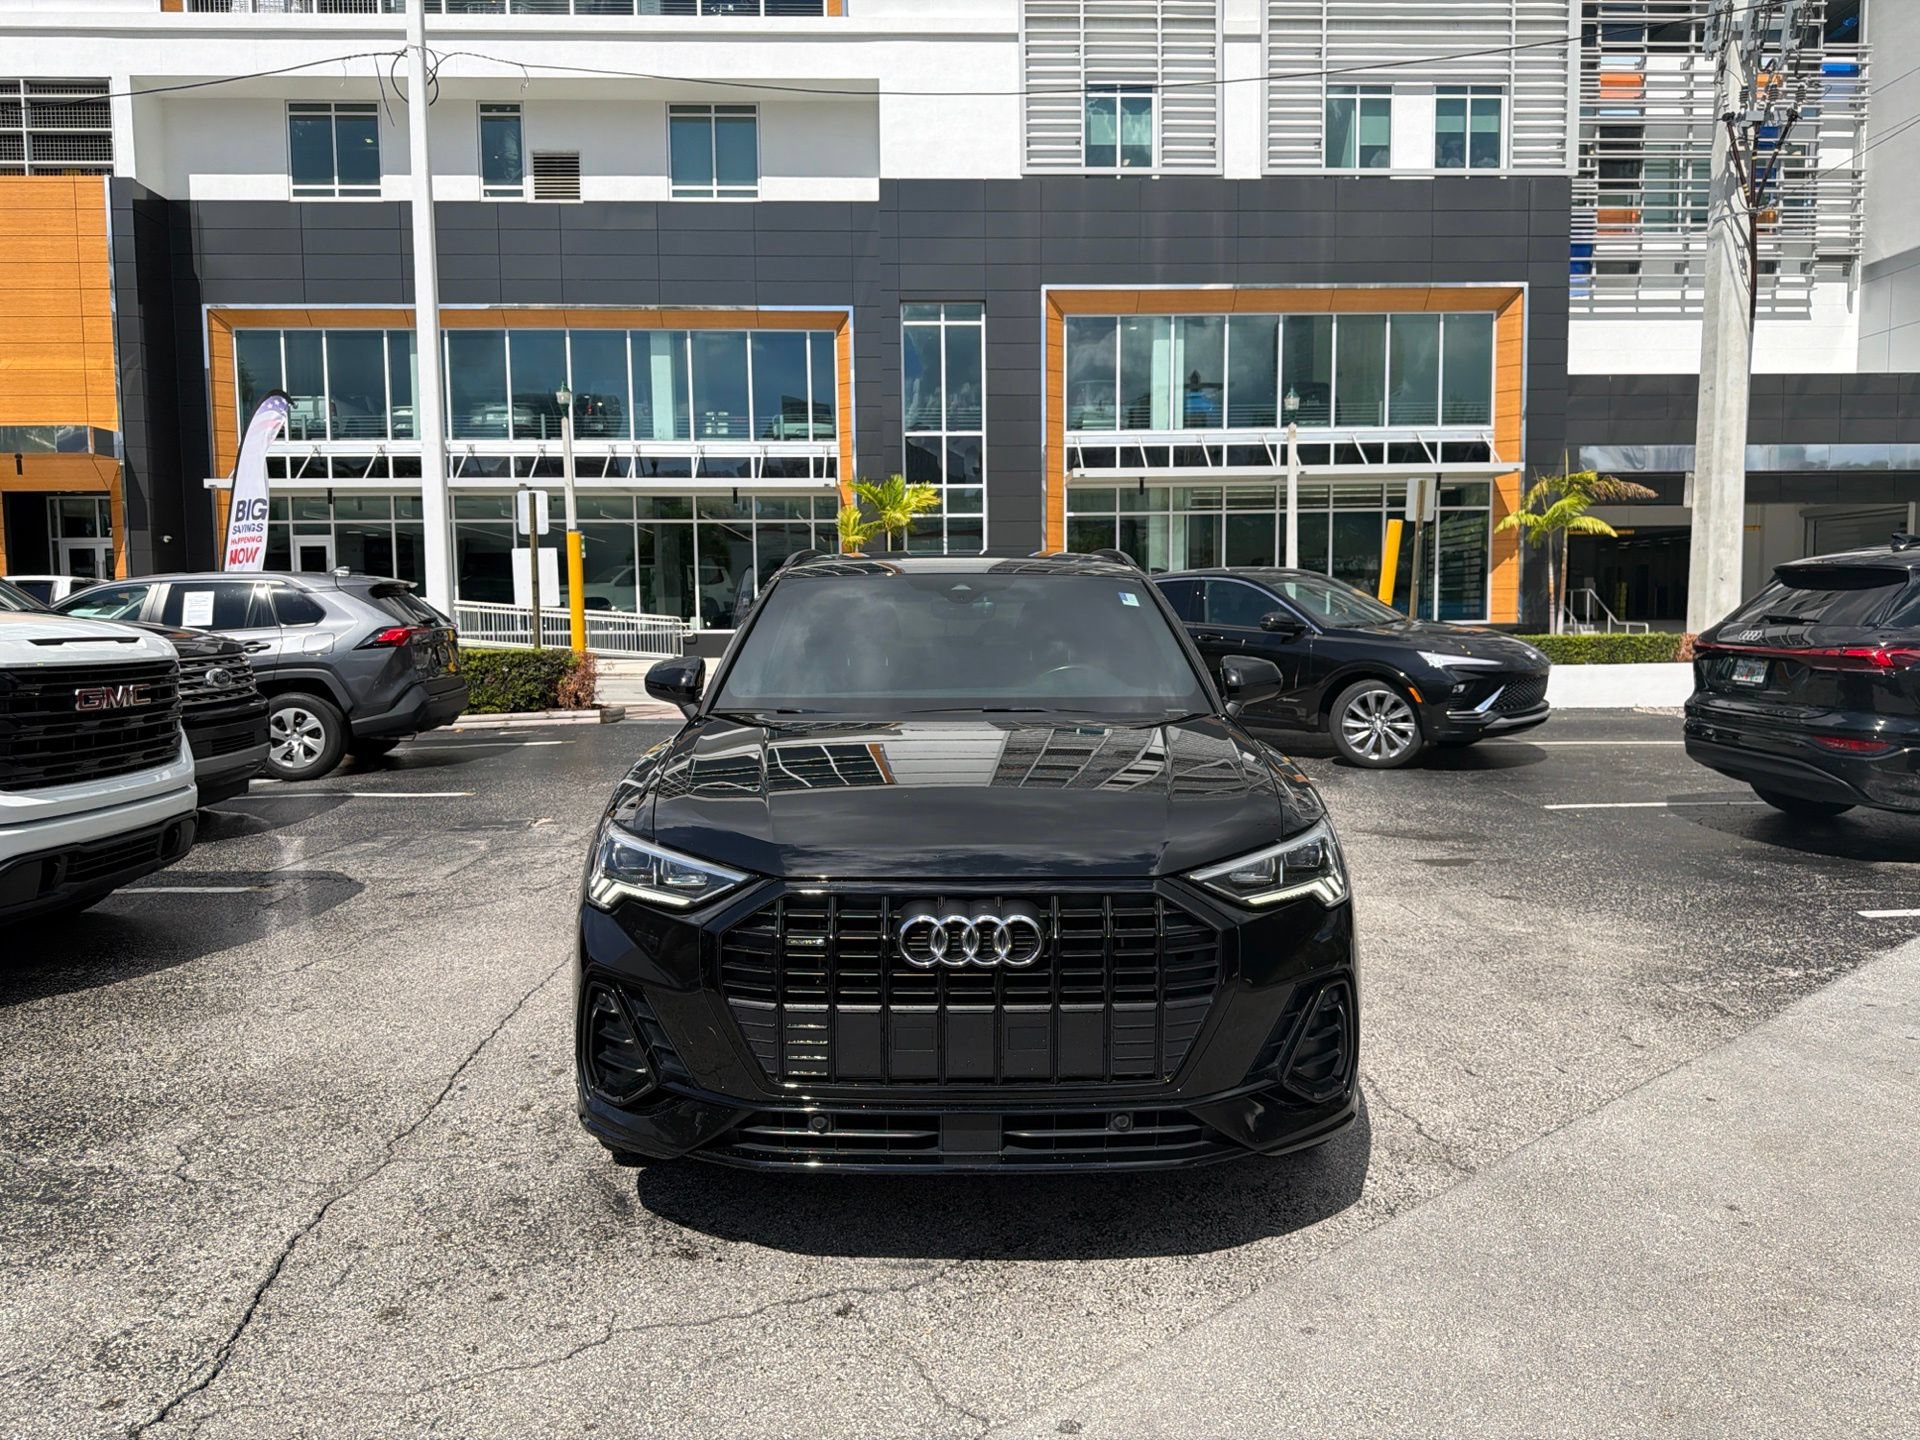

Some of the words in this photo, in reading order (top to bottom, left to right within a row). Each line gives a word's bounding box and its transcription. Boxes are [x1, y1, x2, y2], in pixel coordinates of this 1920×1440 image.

[235, 498, 267, 522] BIG
[232, 523, 264, 535] SAVINGS
[229, 547, 259, 565] NOW
[75, 684, 151, 711] GMC
